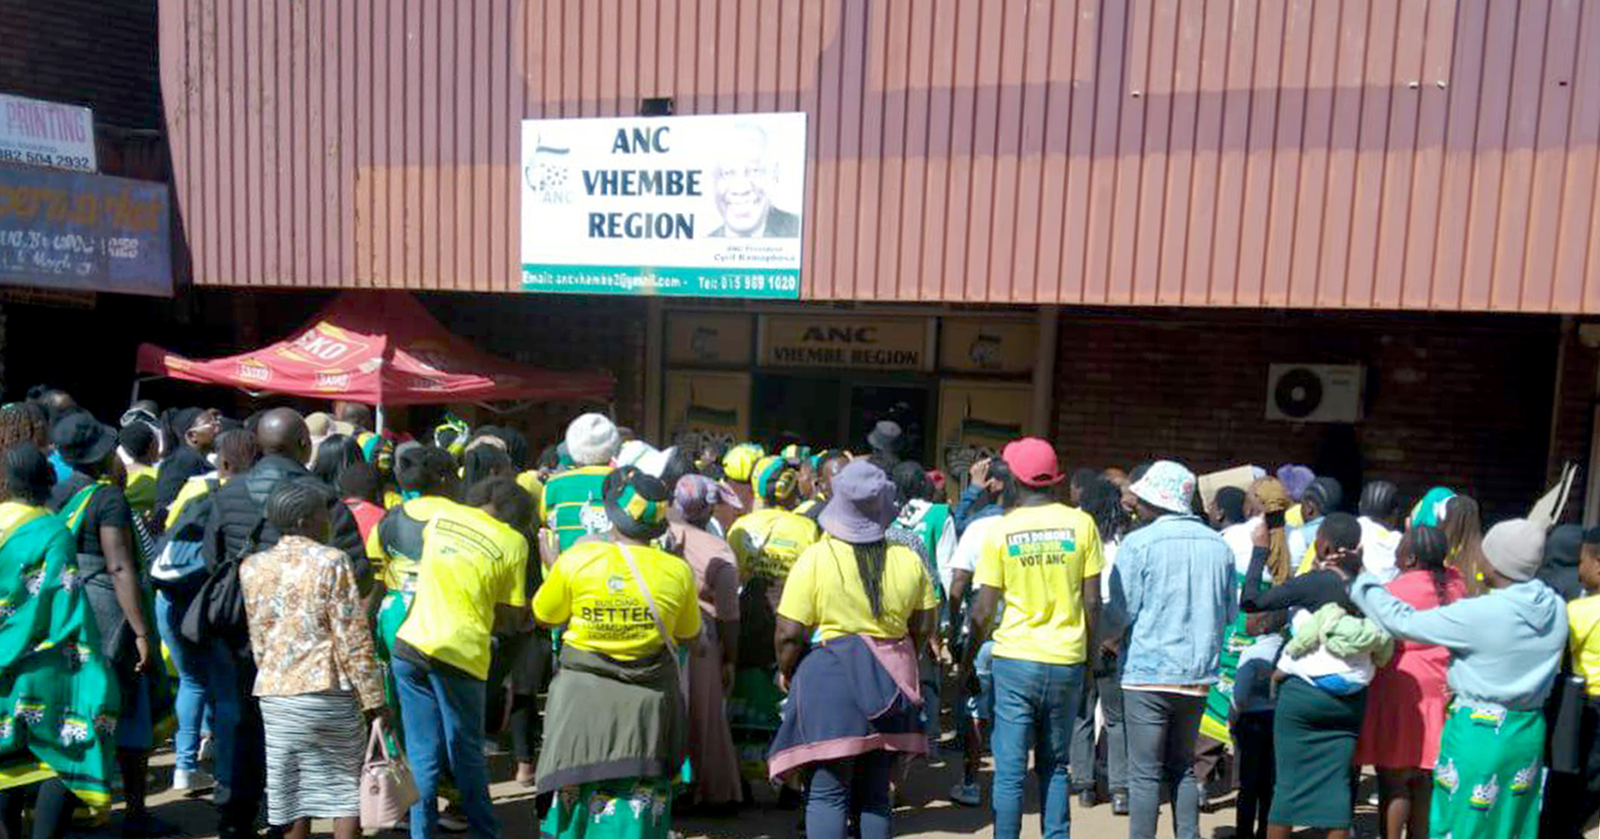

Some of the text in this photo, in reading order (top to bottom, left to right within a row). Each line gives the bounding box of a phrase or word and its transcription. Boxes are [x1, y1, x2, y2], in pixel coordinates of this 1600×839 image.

[7, 102, 86, 142] PRINTING
[611, 126, 670, 154] ANC
[56, 155, 89, 168] 2932
[582, 169, 702, 196] VHEMBE
[588, 212, 694, 239] REGION
[768, 275, 796, 291] 1020
[802, 325, 878, 343] ANC
[773, 346, 918, 365] VHEMBE REGION
[1046, 553, 1066, 565] ANC
[581, 607, 655, 622] BETTER
